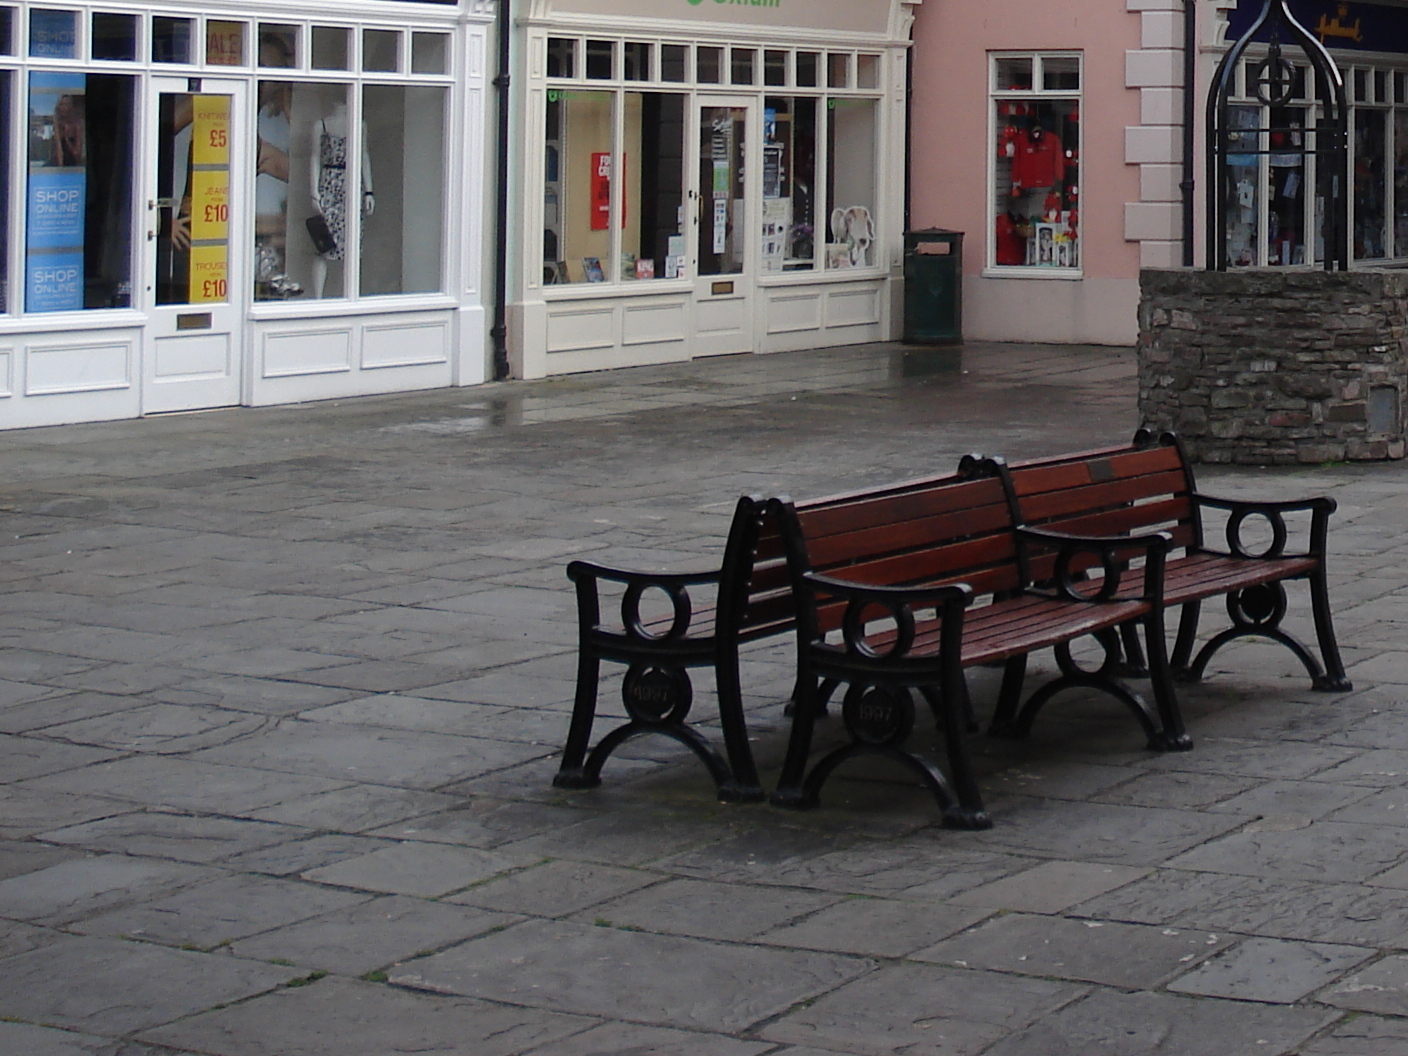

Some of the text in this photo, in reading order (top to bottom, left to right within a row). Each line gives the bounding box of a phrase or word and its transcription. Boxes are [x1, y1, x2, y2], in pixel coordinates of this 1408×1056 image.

[209, 129, 227, 148] £5
[35, 190, 79, 203] SHOP
[35, 203, 79, 214] ONLINE
[204, 204, 229, 222] £10
[34, 269, 78, 283] SHOP
[34, 282, 78, 294] ONLINE
[203, 279, 227, 298] £10
